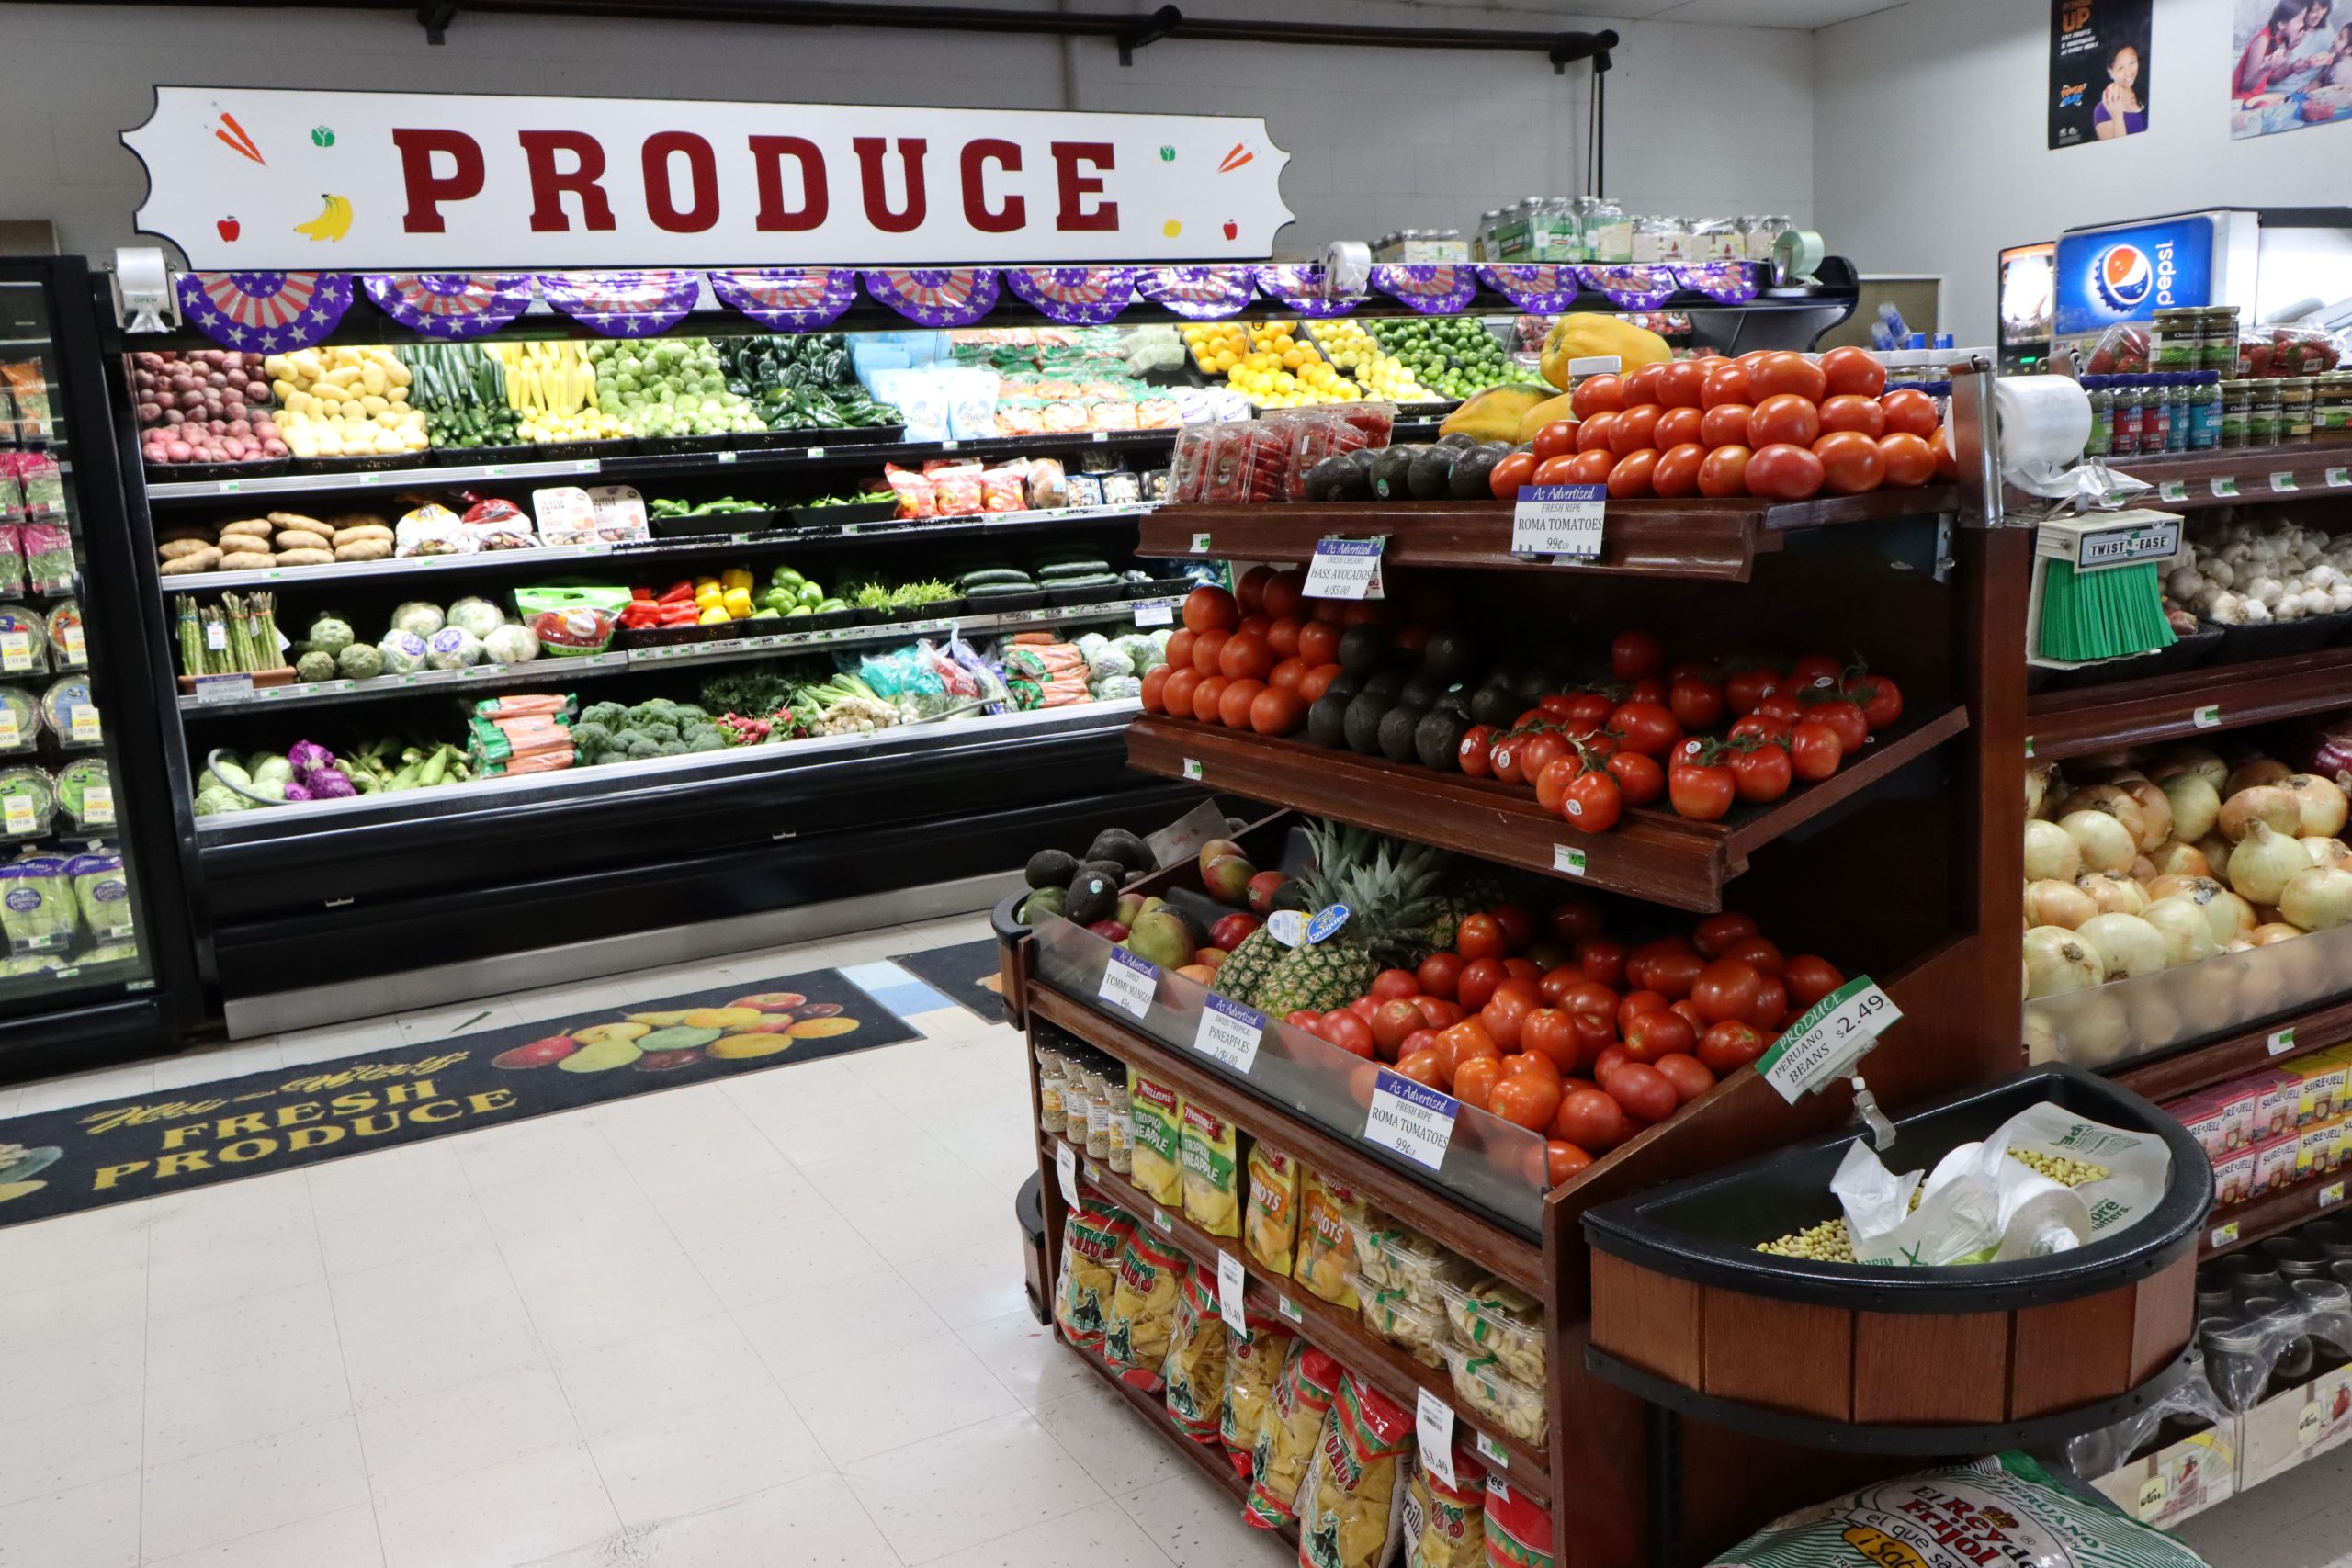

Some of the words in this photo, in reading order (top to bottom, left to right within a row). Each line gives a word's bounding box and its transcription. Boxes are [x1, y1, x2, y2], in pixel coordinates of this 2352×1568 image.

[2063, 7, 2091, 33] UP
[391, 127, 1121, 234] PRODUCE
[2155, 241, 2177, 306] pepsi
[1532, 487, 1545, 501] As
[1547, 486, 1595, 501] Advertised
[1541, 502, 1565, 513] FRESH
[1565, 502, 1583, 513] RIPE
[1518, 518, 1546, 531] ROMA
[1549, 517, 1603, 531] TOMATOES
[1326, 544, 1337, 554] As
[1337, 543, 1373, 556] Advertised
[1326, 557, 1343, 565] FRESH
[1343, 557, 1366, 566] CREAMY
[2091, 542, 2125, 557] TWIST
[1310, 567, 1331, 580] HASS
[1331, 568, 1372, 581] AVOCADOS
[1119, 952, 1127, 964] As
[1126, 955, 1155, 976] Advertised
[1106, 974, 1128, 994] TOMMY
[1128, 985, 1152, 1006] MANGOS
[1215, 1014, 1231, 1029] SWEET
[1231, 1021, 1251, 1037] TROPICAL
[1216, 998, 1225, 1011] As
[1225, 1003, 1259, 1027] Advertised
[1778, 991, 1845, 1052] PRODUCE
[1837, 995, 1884, 1039] $2.49
[1209, 1025, 1250, 1055] PINEAPPLES
[1774, 1029, 1824, 1079] PERUANO
[1789, 1043, 1831, 1084] BEANS
[1389, 1079, 1402, 1095] As
[1402, 1085, 1449, 1113] Advertised
[1396, 1100, 1417, 1117] FRESH
[1417, 1108, 1433, 1123] RIPE
[161, 1078, 438, 1151] FRESH
[1372, 1107, 1398, 1129] ROMA
[1400, 1118, 1450, 1149] TOMATOES
[91, 1088, 519, 1191] PRODUCE
[1125, 1288, 1148, 1303] BRAND
[1422, 1446, 1449, 1476] $3.49
[1911, 1485, 1947, 1502] El
[1939, 1497, 2015, 1544] Rey
[1996, 1478, 2100, 1549] PERUANO
[1866, 1513, 1884, 1527] el
[1891, 1524, 1929, 1550] que
[1896, 1498, 2002, 1568] Frijol
